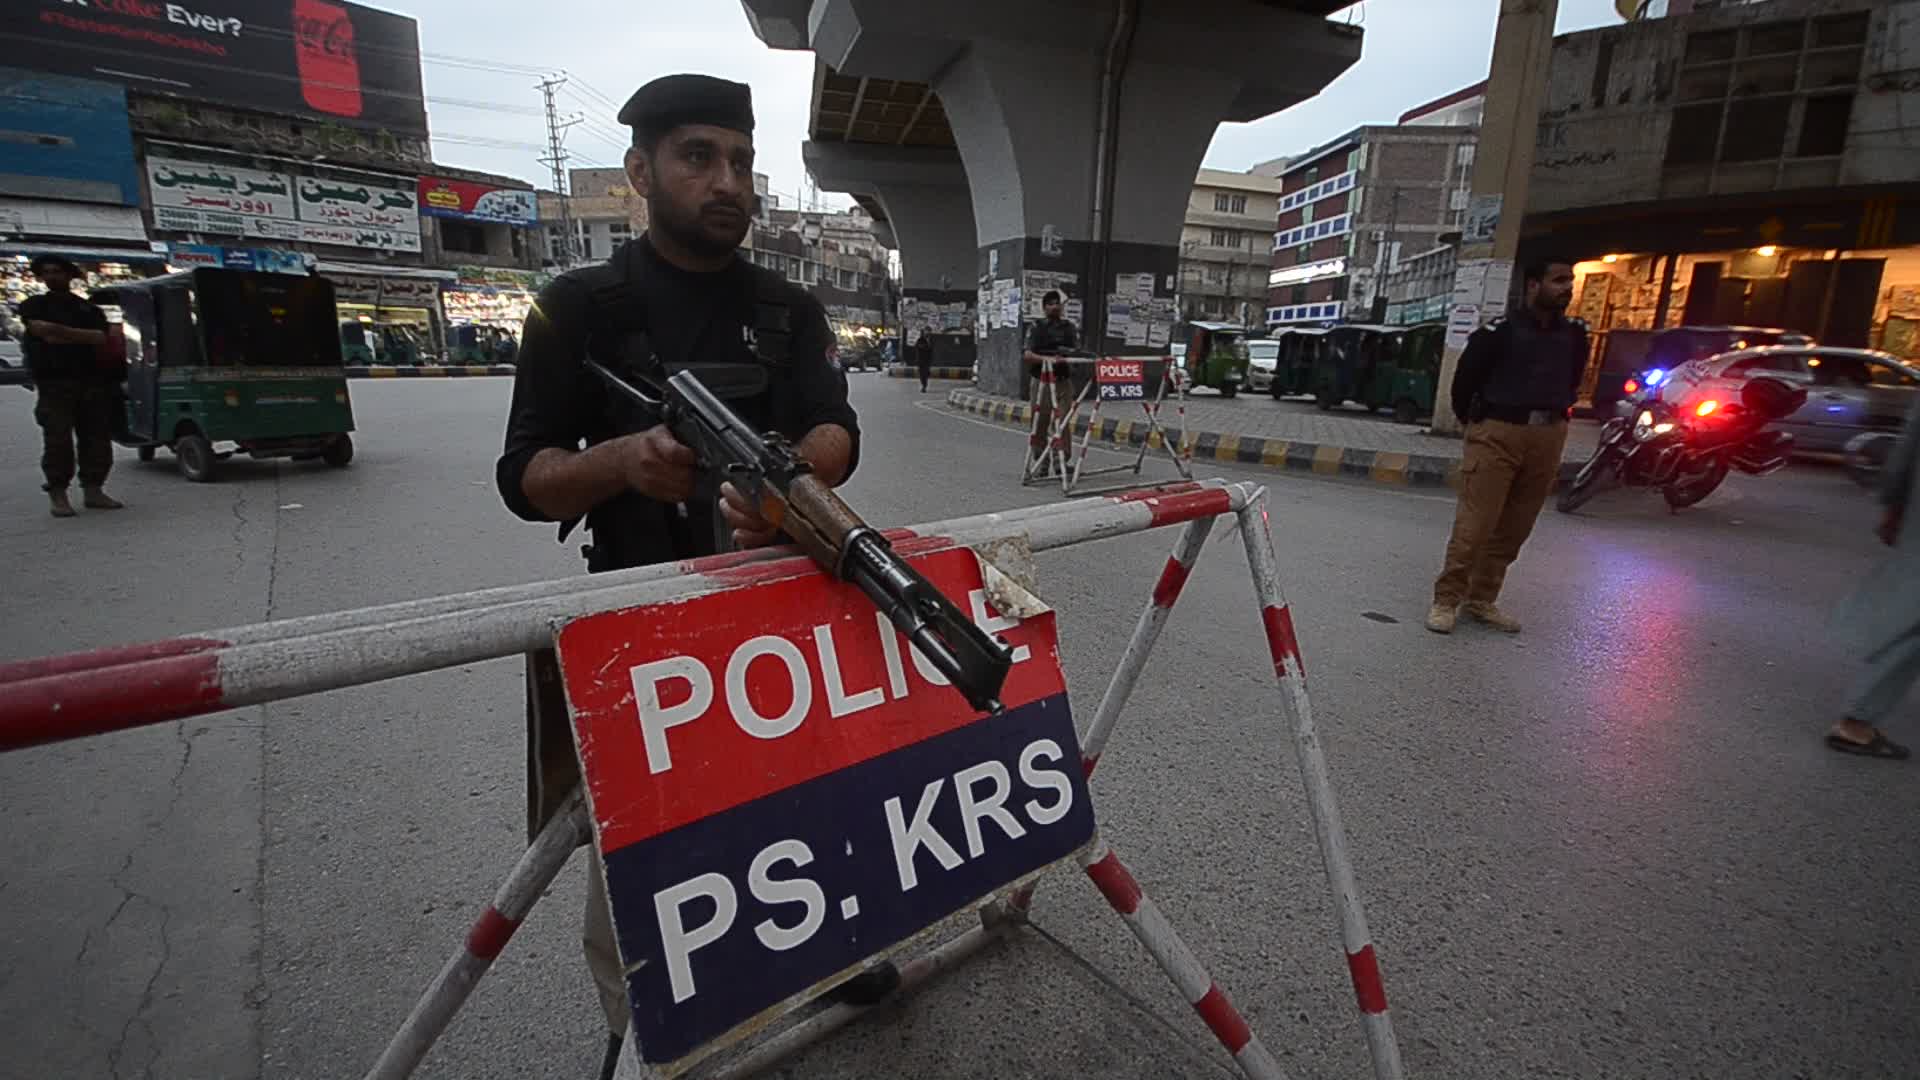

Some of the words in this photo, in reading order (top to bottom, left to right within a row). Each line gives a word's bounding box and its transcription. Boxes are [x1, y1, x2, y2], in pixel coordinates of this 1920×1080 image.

[166, 3, 243, 37] Ever?
[301, 179, 415, 211] حرمین
[1100, 364, 1140, 377] POLICE
[1101, 385, 1119, 397] PS.
[1120, 385, 1144, 397] KRS
[654, 838, 860, 1004] PS.
[884, 739, 1074, 893] KRS
